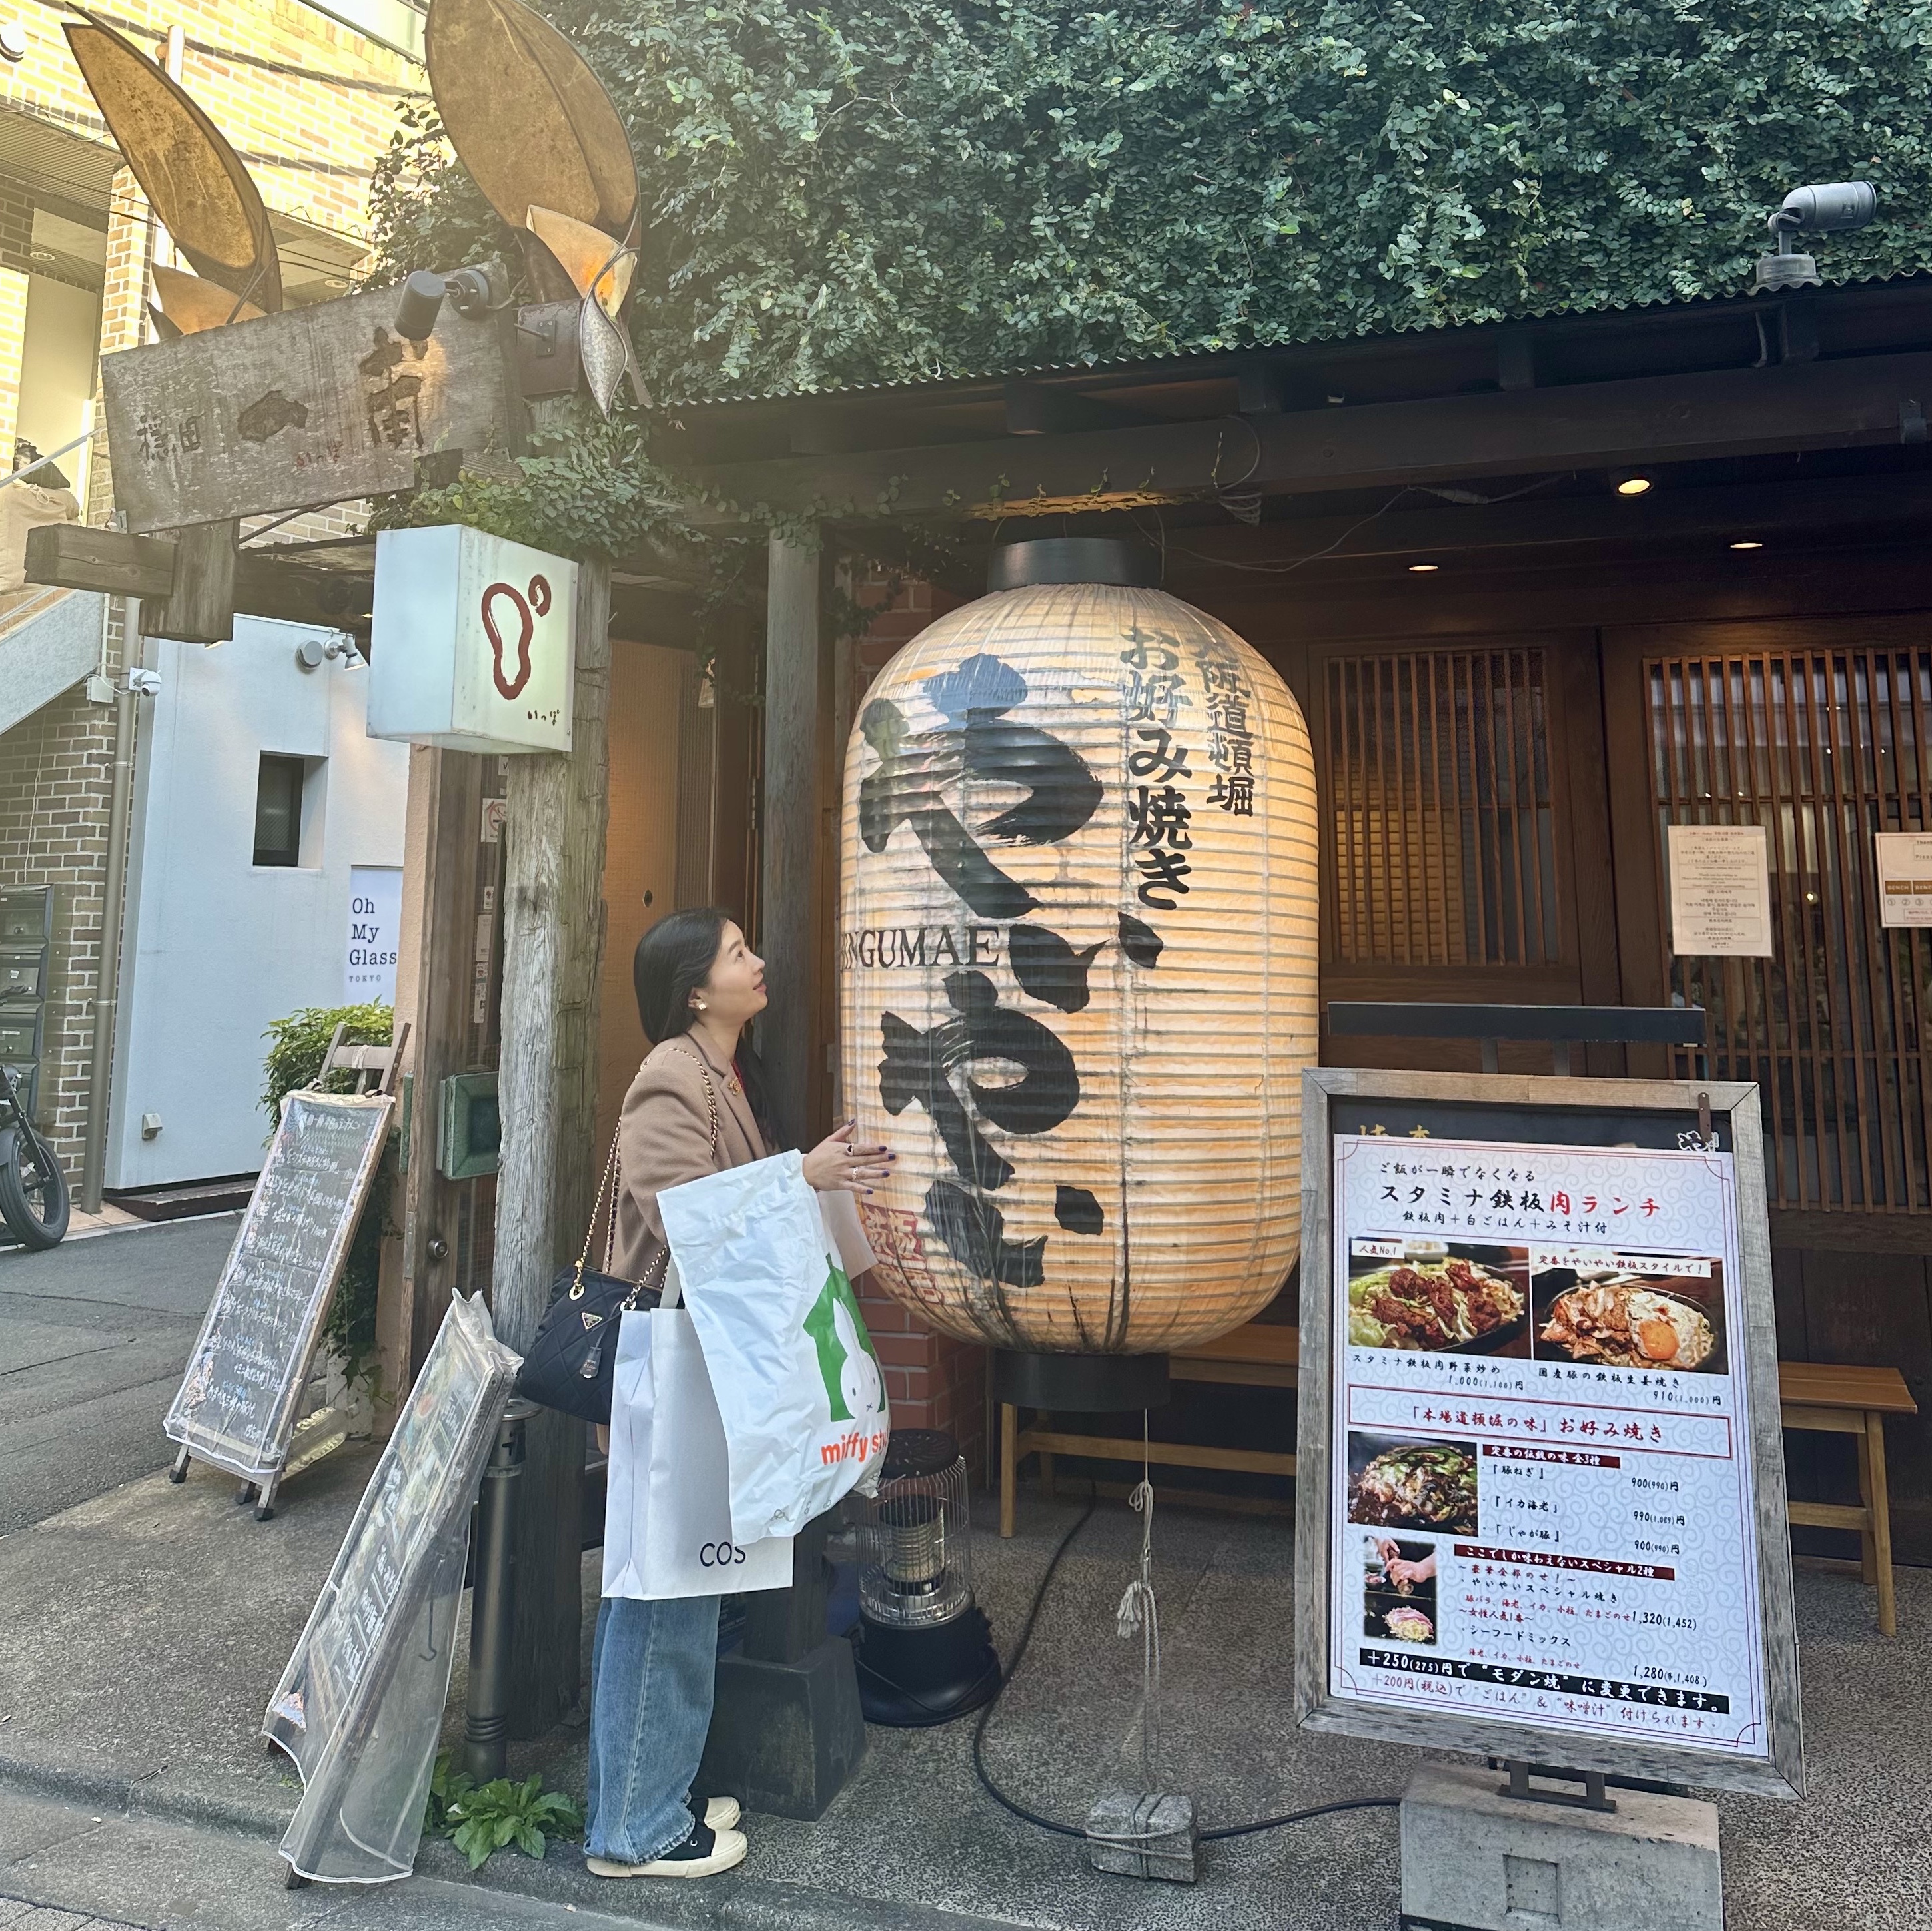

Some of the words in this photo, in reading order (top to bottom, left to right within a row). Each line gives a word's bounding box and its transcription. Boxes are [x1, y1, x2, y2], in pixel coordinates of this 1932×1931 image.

[1119, 626, 1193, 910] お好み焼き
[352, 897, 375, 914] Oh
[351, 923, 380, 943] My
[1380, 1162, 1535, 1182] ご飯が一瞬でなくなる
[1380, 1186, 1660, 1217] スタミナ鉄板肉ランチ
[1354, 1355, 1500, 1374] スタミナ鉄板肉野菜炒め
[1539, 1367, 1680, 1388] 国産豚の鉄板生姜焼き
[821, 1432, 868, 1465] miffy
[700, 1541, 746, 1567] COS
